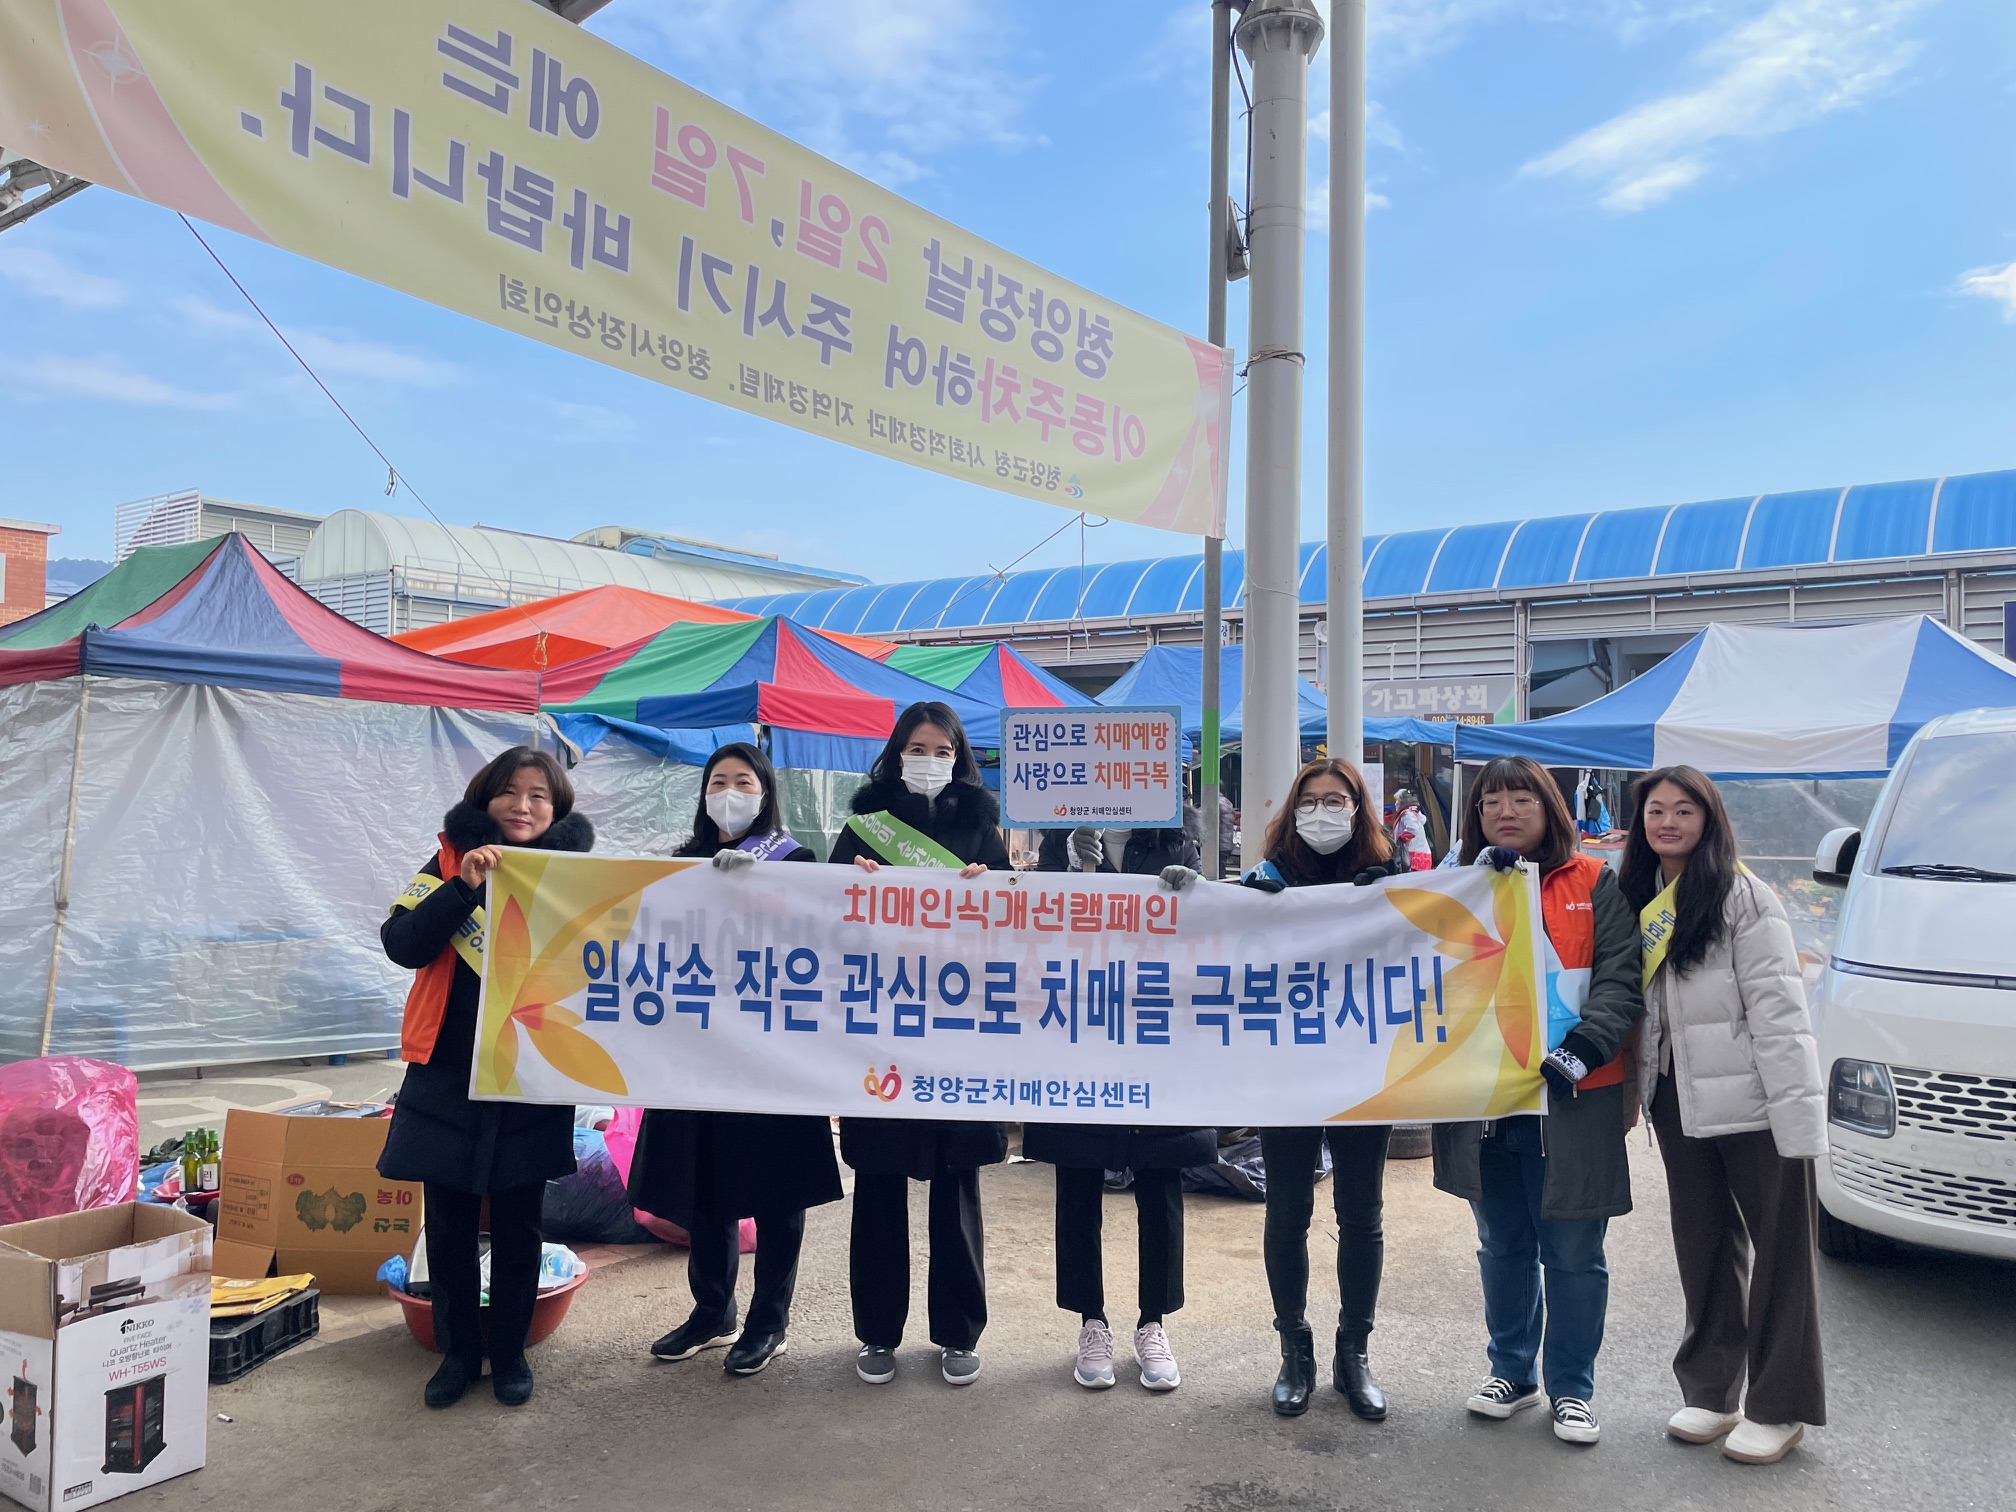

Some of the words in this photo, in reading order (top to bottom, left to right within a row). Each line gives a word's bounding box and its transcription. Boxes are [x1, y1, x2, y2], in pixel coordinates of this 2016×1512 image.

[1370, 685, 1487, 712] 가고파상회
[1013, 723, 1087, 751] 관심으로
[1094, 722, 1169, 751] 치매예방
[1013, 762, 1088, 791] 사랑으로
[1094, 761, 1169, 790] 치매극복
[1069, 806, 1090, 816] 청양군
[1091, 806, 1132, 816] 치매안심센터
[843, 882, 1178, 936] 치매인식개선캠페인
[582, 939, 716, 1030] 일상속
[734, 947, 822, 1032] 작은
[839, 952, 1022, 1038] 관심으로
[1038, 959, 1175, 1046] 치매를
[1191, 955, 1448, 1047] 극복합시다!
[911, 1075, 1152, 1110] 청양군치매안심센터
[376, 1188, 413, 1206] 아욱
[373, 1217, 410, 1233] 논산
[123, 1335, 136, 1344] FIVE
[137, 1331, 152, 1341] FACE
[126, 1319, 154, 1333] NIKKO
[110, 1343, 138, 1357] Quartz
[139, 1335, 167, 1349] Heater
[103, 1359, 116, 1368] 니코
[108, 1356, 167, 1381] WH-T55WS
